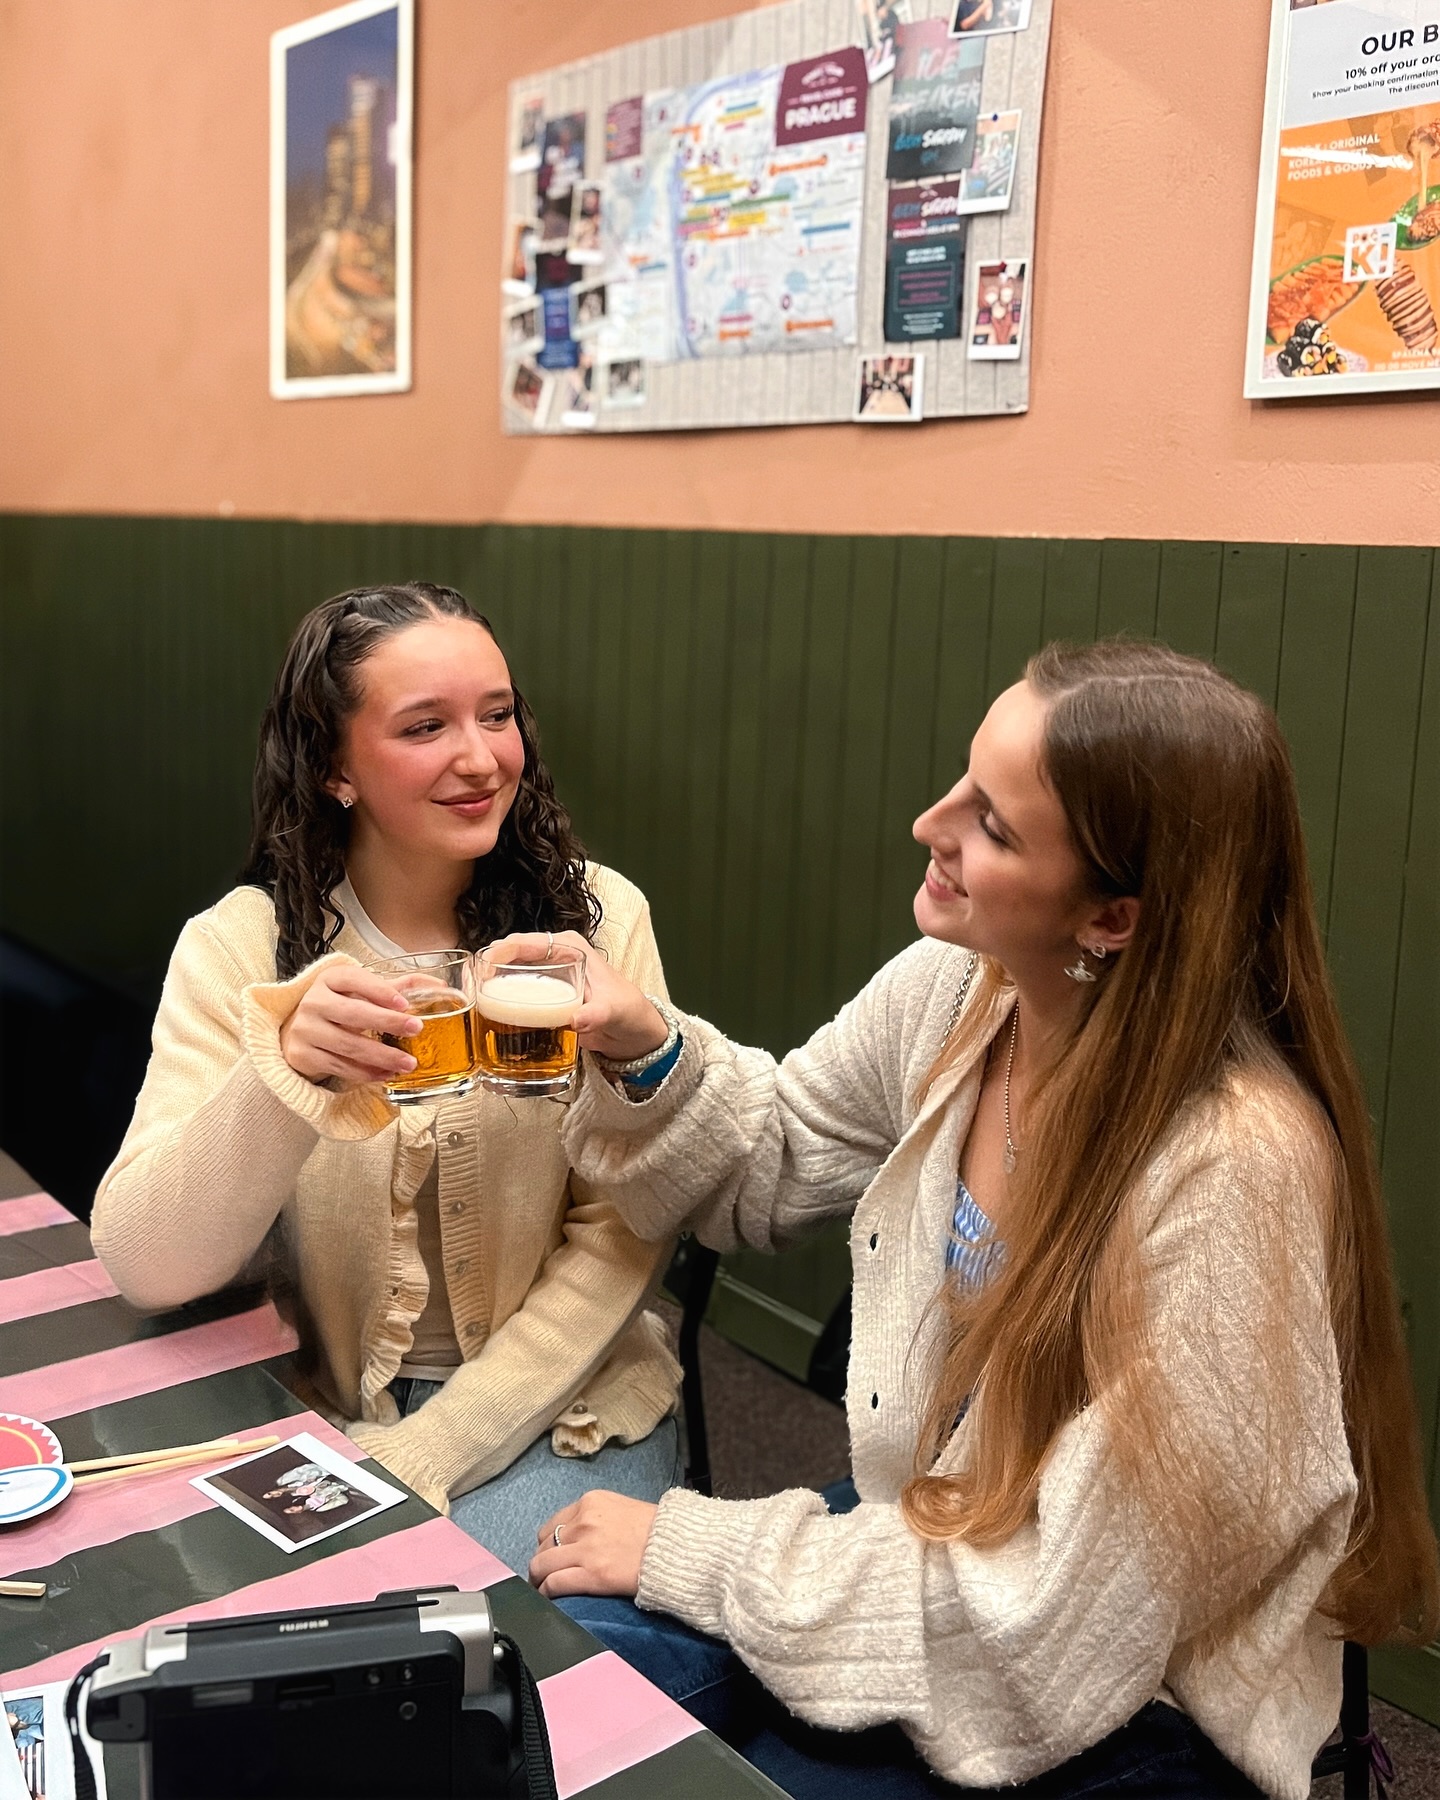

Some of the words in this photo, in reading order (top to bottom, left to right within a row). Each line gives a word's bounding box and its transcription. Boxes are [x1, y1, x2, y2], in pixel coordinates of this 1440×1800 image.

[1361, 29, 1415, 56] OUR
[1345, 66, 1367, 80] 10%
[1371, 61, 1388, 75] off
[1390, 57, 1418, 74] your
[1312, 90, 1332, 99] Show
[1334, 86, 1352, 97] your
[1353, 79, 1385, 92] booking
[1387, 70, 1439, 85] confirmation
[1389, 86, 1403, 96] The
[1405, 79, 1439, 93] discount
[785, 97, 857, 131] PRAGUE
[1329, 133, 1381, 149] ORIGINAL
[1287, 168, 1322, 181] FOODS
[1324, 166, 1332, 176] &
[1334, 162, 1372, 174] GOODS
[1288, 157, 1328, 169] KORE
